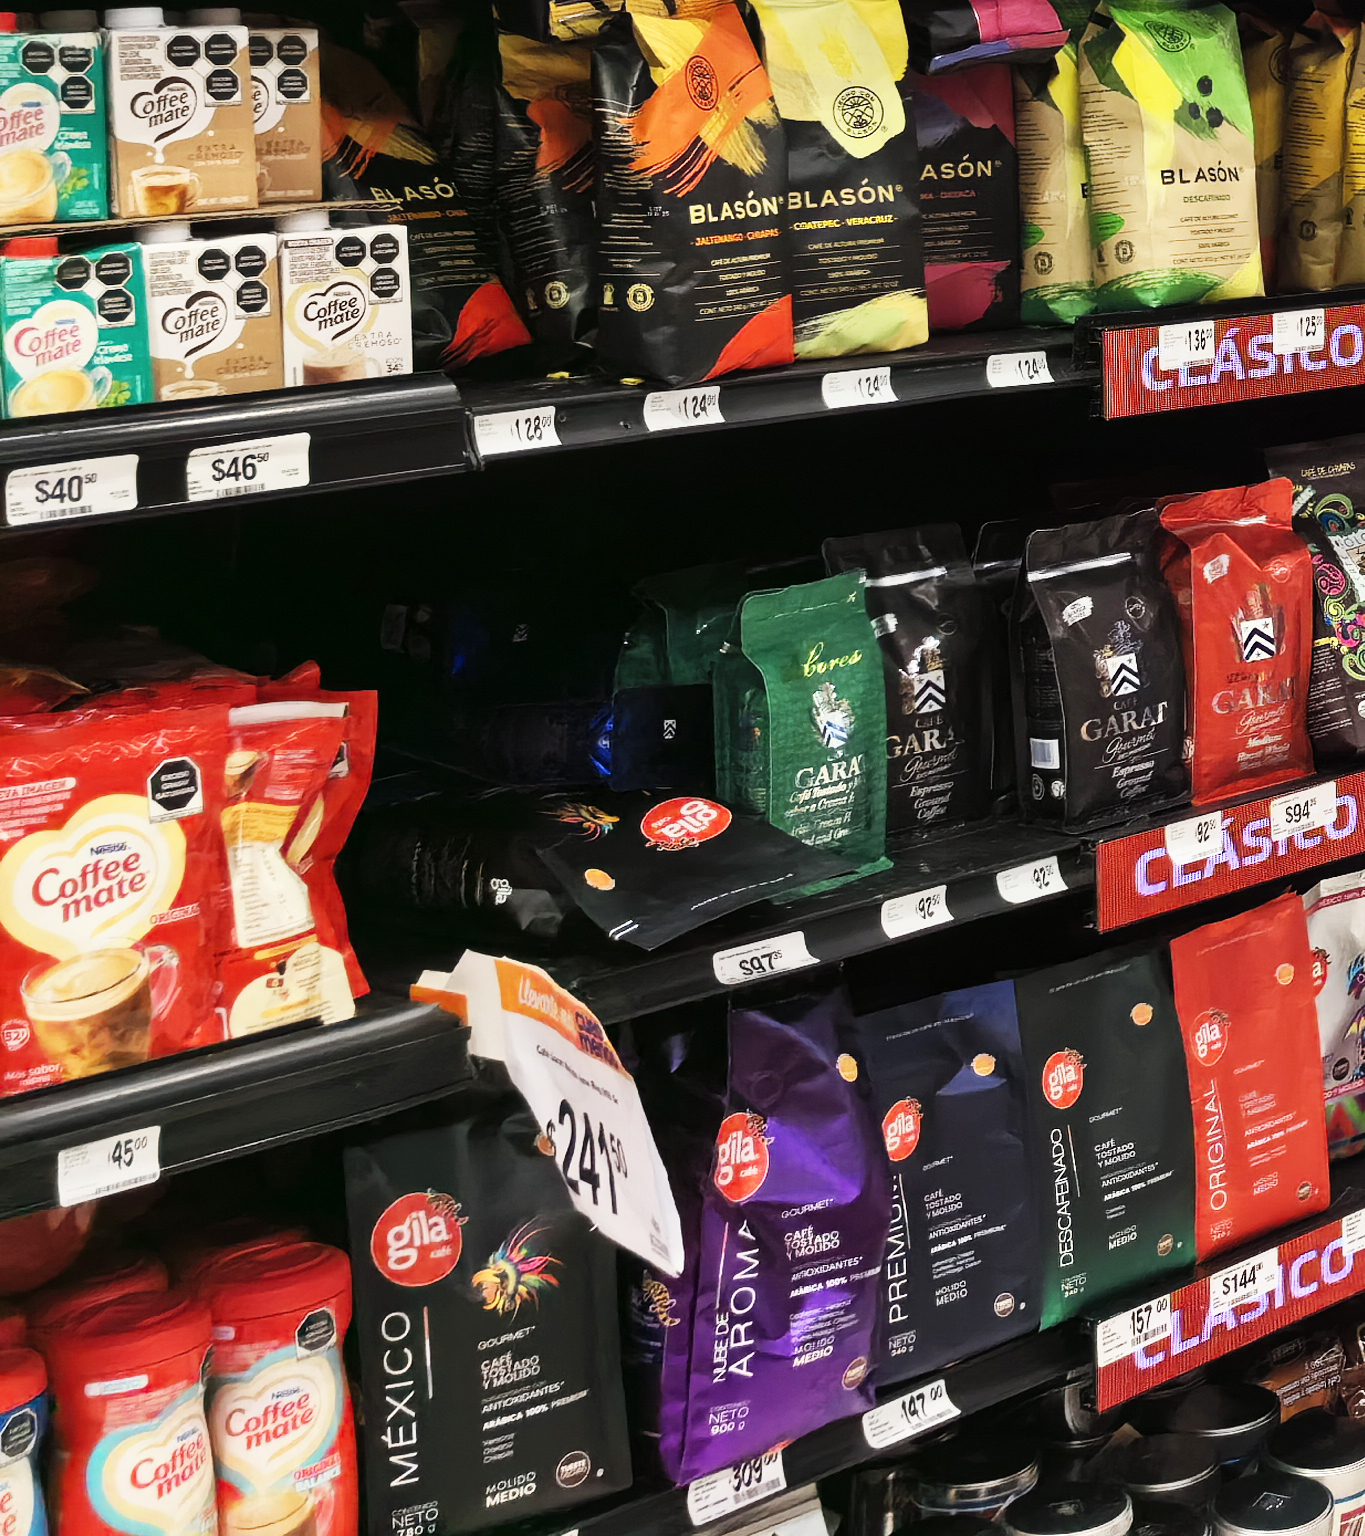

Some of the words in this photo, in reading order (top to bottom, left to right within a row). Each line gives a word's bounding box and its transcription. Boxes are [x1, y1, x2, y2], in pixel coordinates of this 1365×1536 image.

[1160, 160, 1239, 185] BLASÓN
[689, 191, 777, 225] BLASÓN
[787, 181, 896, 211] BLASÓN
[1081, 701, 1169, 743] GARAT
[32, 850, 141, 908] Coffee
[61, 870, 148, 922] mate
[1048, 1064, 1078, 1101] gila
[1209, 1079, 1228, 1212] ORIGINAL
[1049, 1127, 1075, 1268] DESCAFEINADO
[387, 1208, 448, 1271] gila
[225, 1394, 312, 1438] Coffee
[380, 1310, 418, 1487] MÉXICO
[246, 1407, 315, 1451] mate
[486, 1470, 536, 1495] MOLIDO
[486, 1482, 537, 1508] MEDIO
[392, 1505, 440, 1529] NETO
